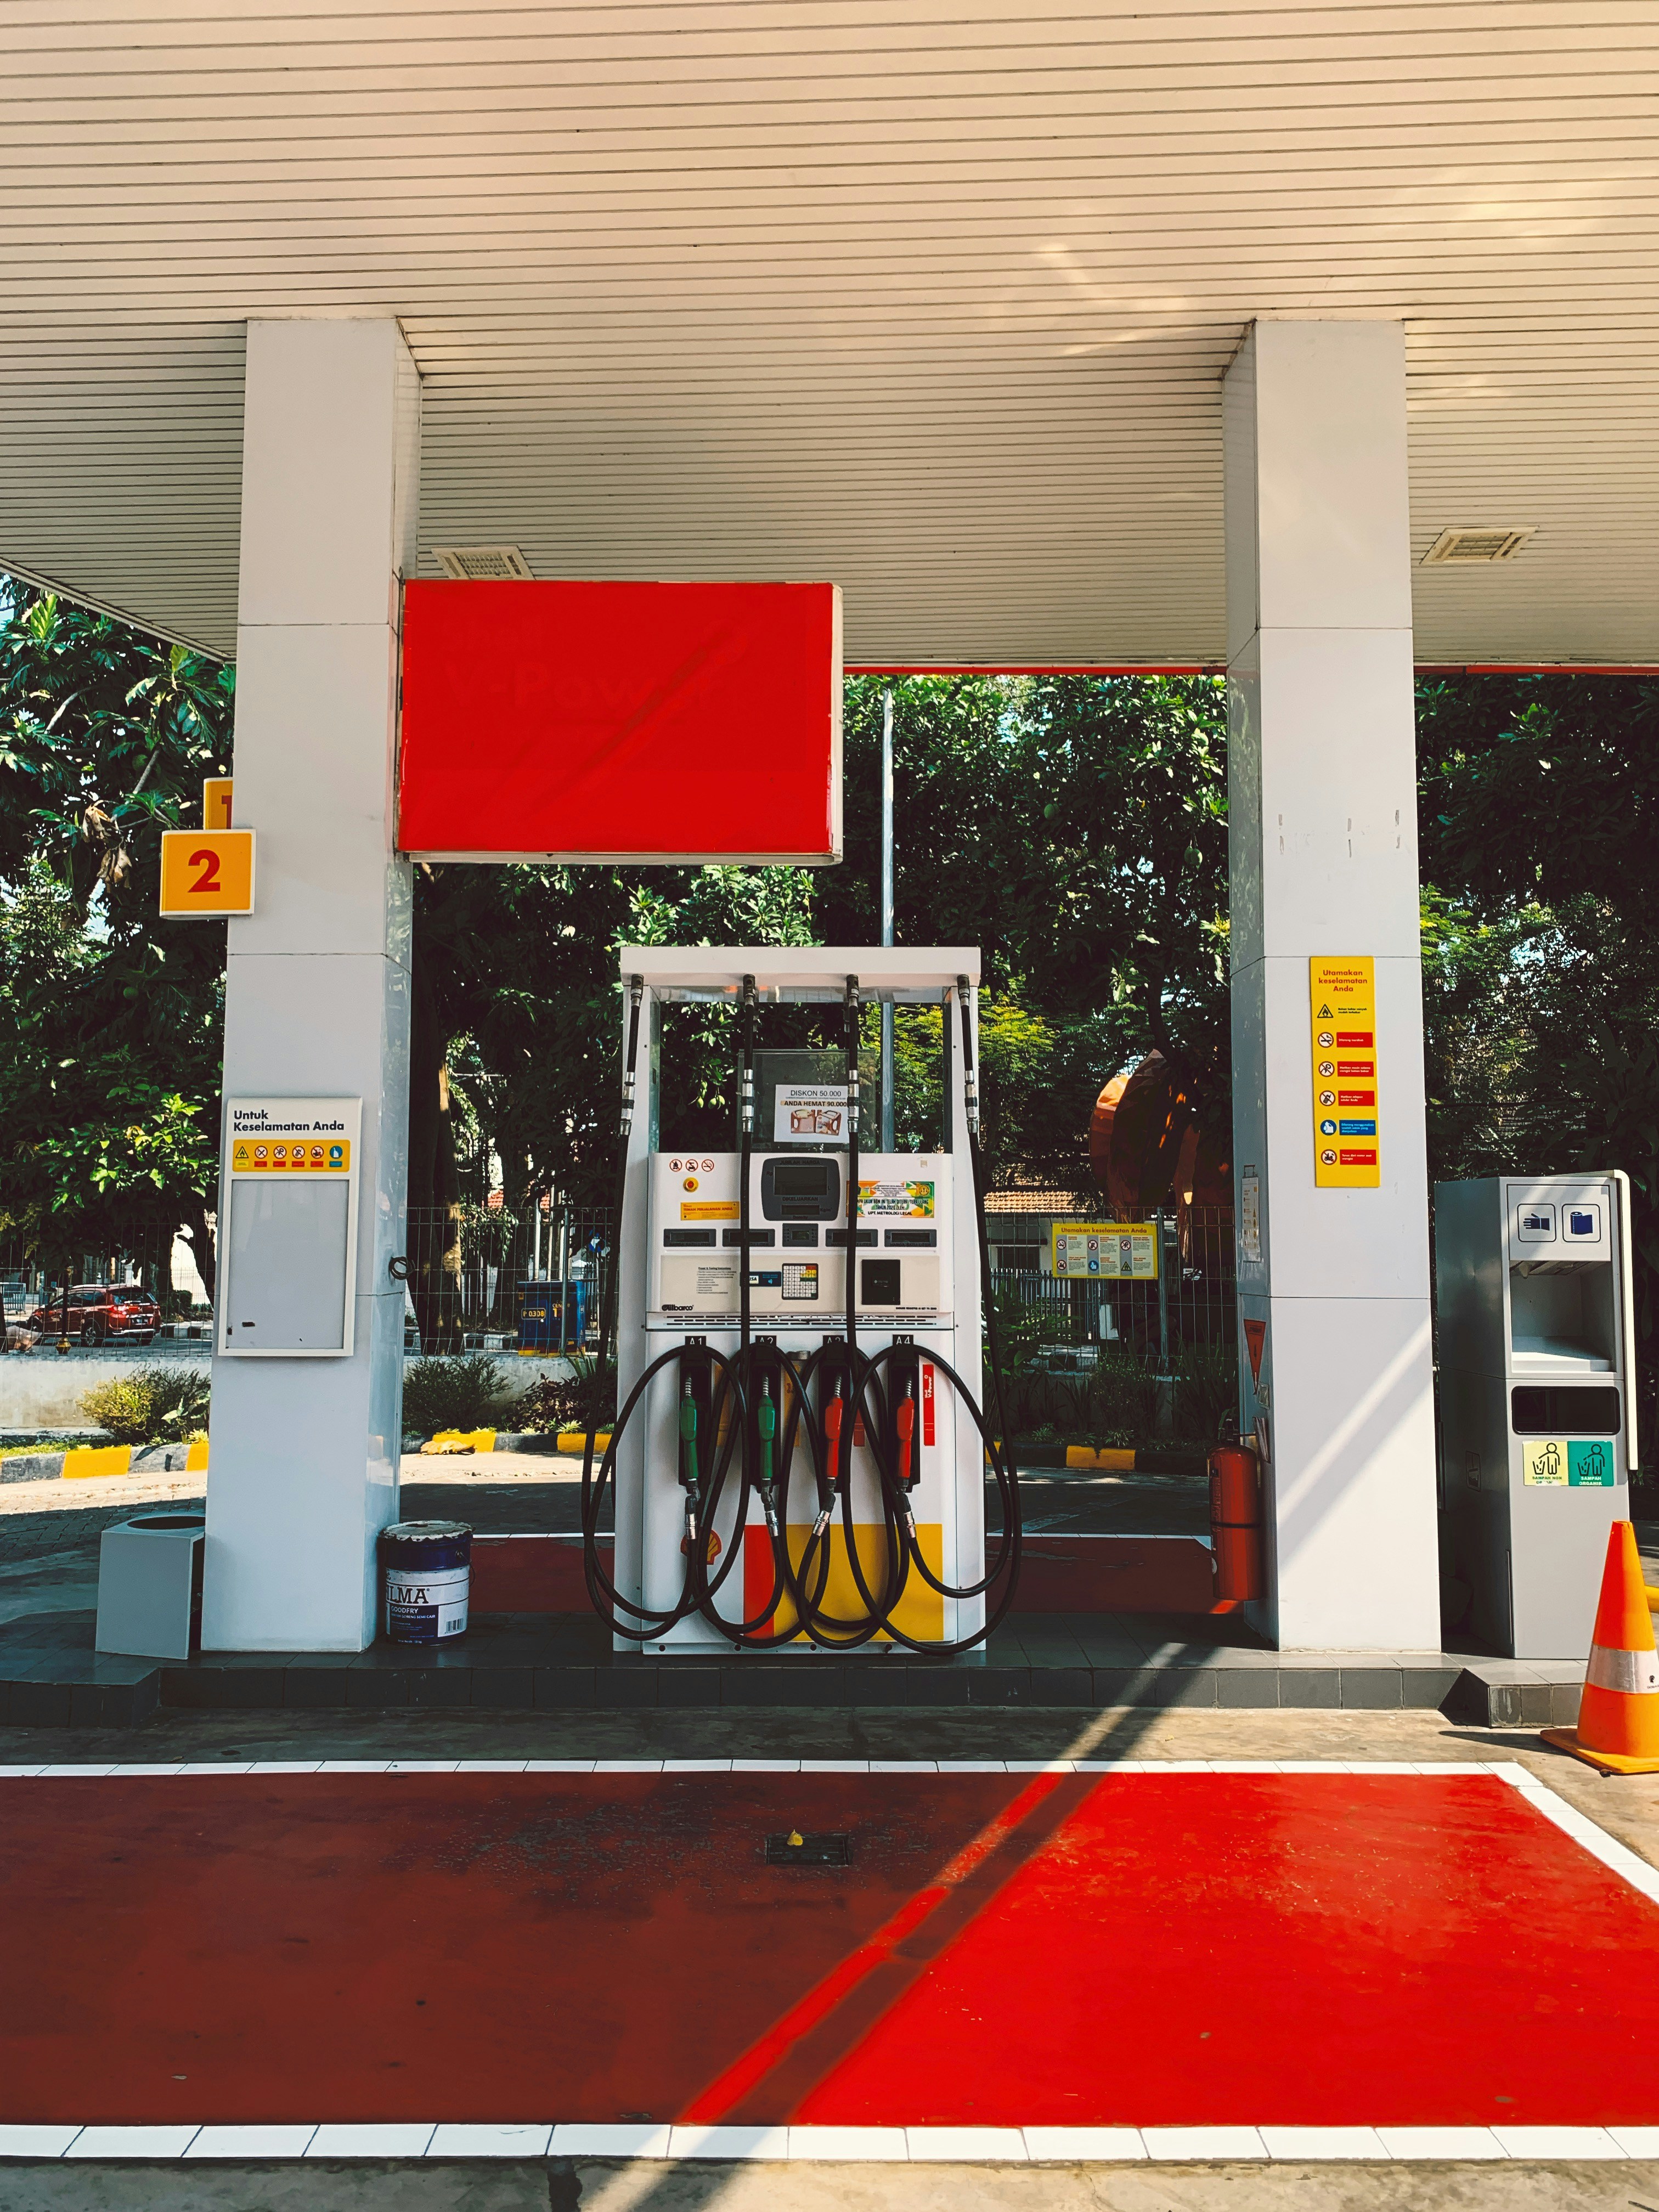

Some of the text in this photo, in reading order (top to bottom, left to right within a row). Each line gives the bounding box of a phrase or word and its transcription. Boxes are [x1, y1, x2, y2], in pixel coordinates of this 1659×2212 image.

[188, 849, 221, 893] 2
[234, 1109, 268, 1119] Untuk
[234, 1120, 345, 1131] Keselamatan Anda
[391, 1606, 419, 1614] GOODFRY
